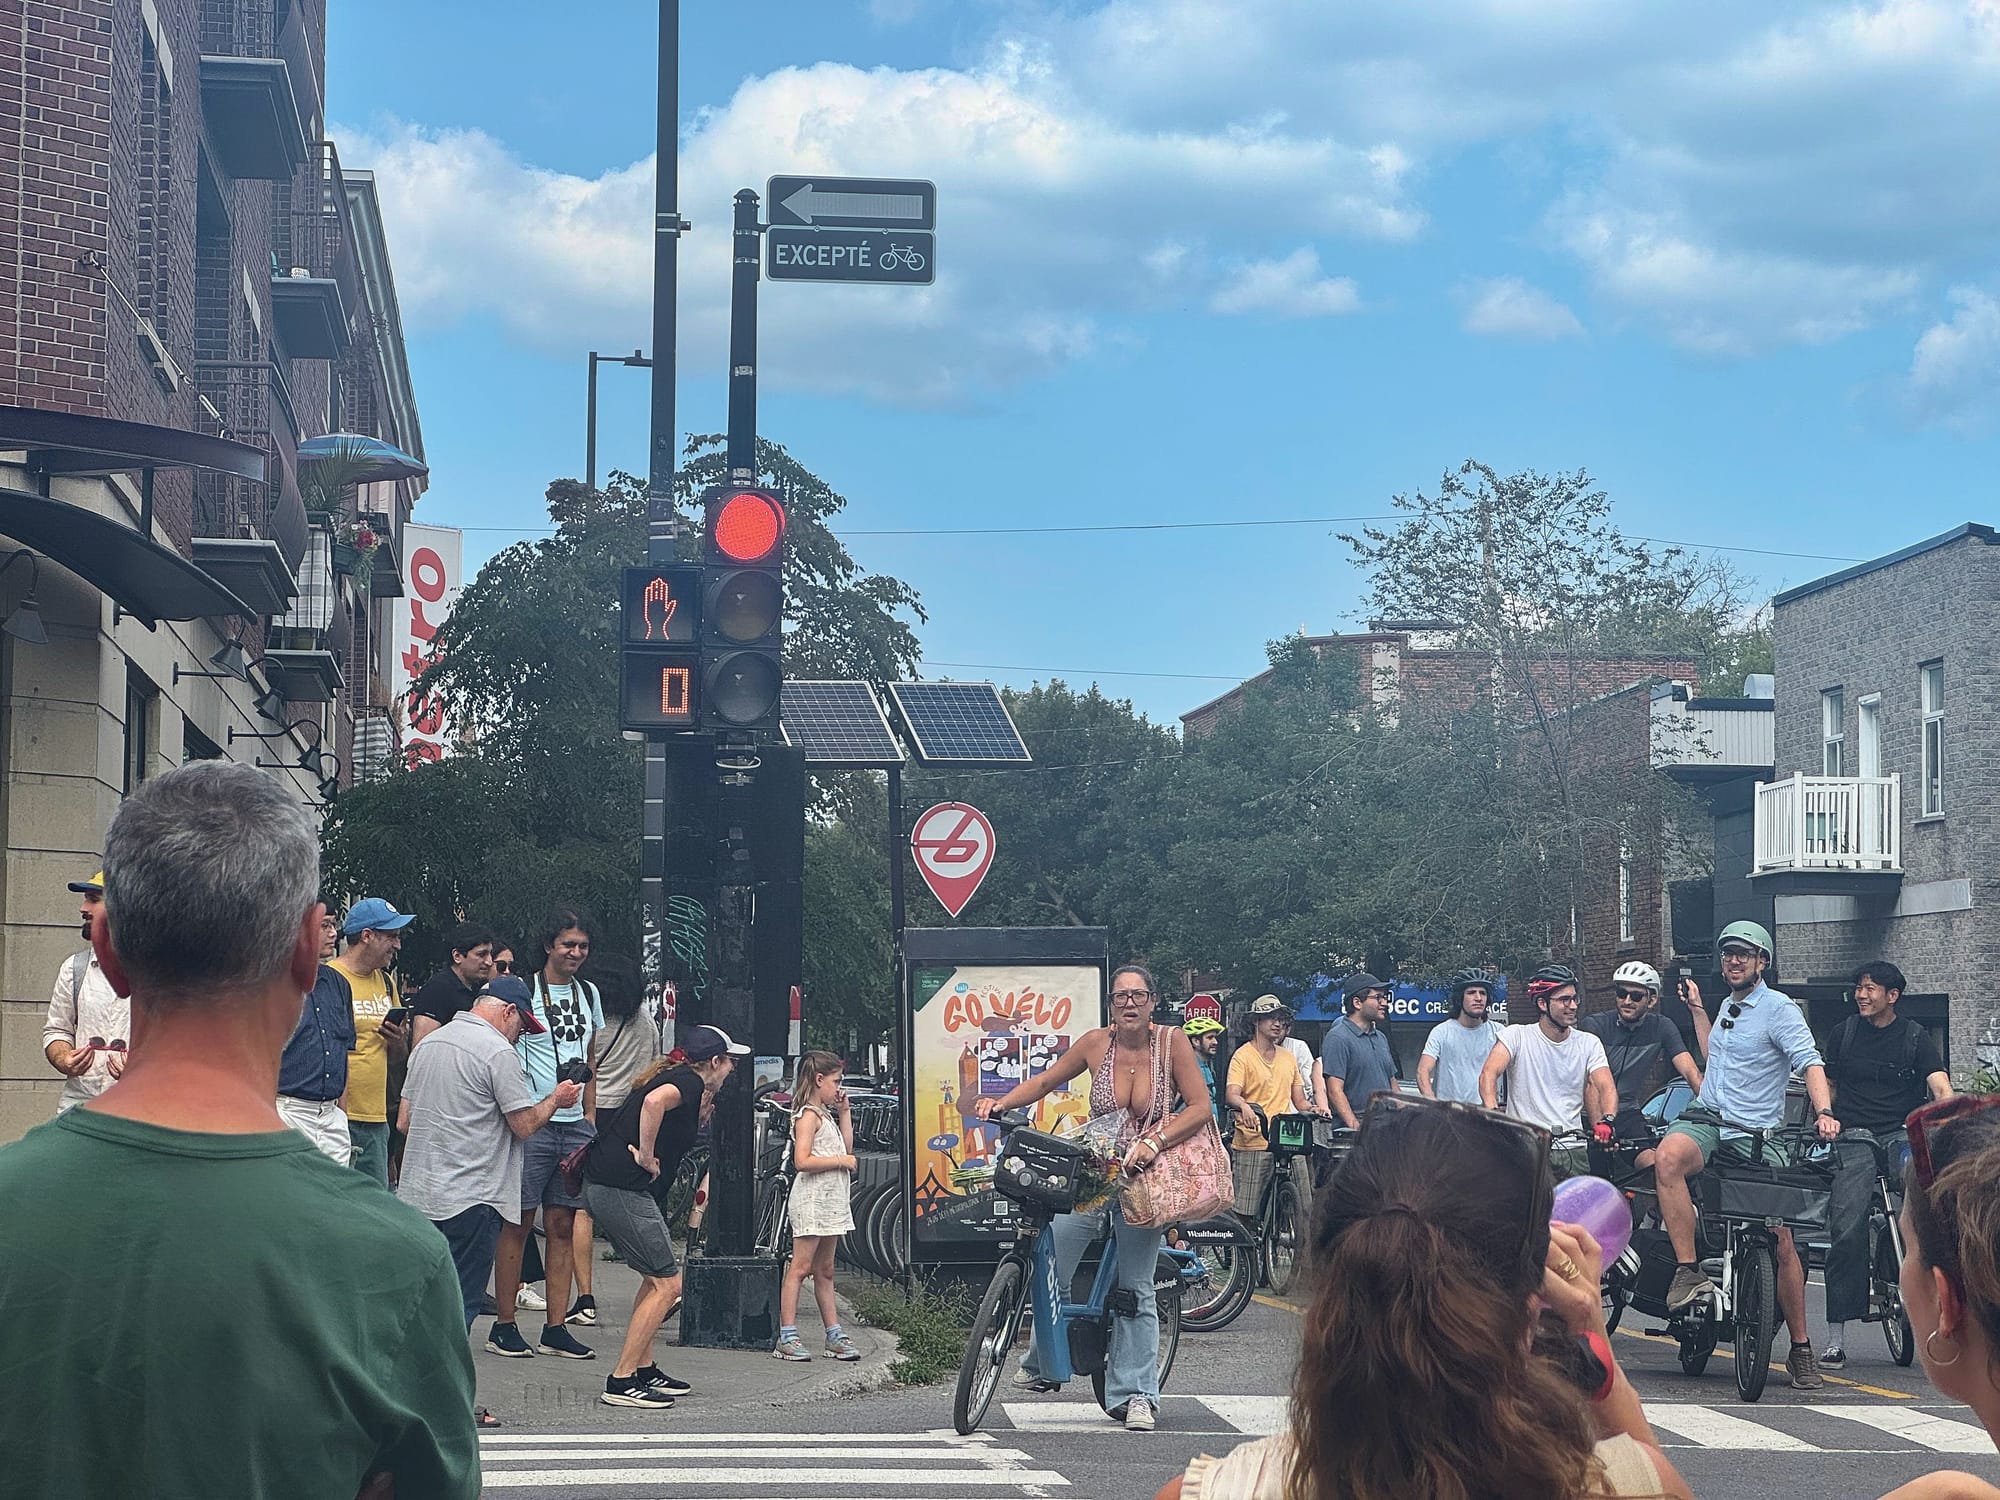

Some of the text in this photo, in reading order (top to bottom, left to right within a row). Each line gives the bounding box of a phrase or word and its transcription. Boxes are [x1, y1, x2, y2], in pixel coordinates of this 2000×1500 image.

[775, 240, 871, 268] EXCEPTÉ
[662, 667, 689, 714] 0
[943, 985, 1072, 1033] GO VÉLO
[1186, 1006, 1219, 1019] ARRÊT
[1186, 1230, 1234, 1239] Wealthsimple
